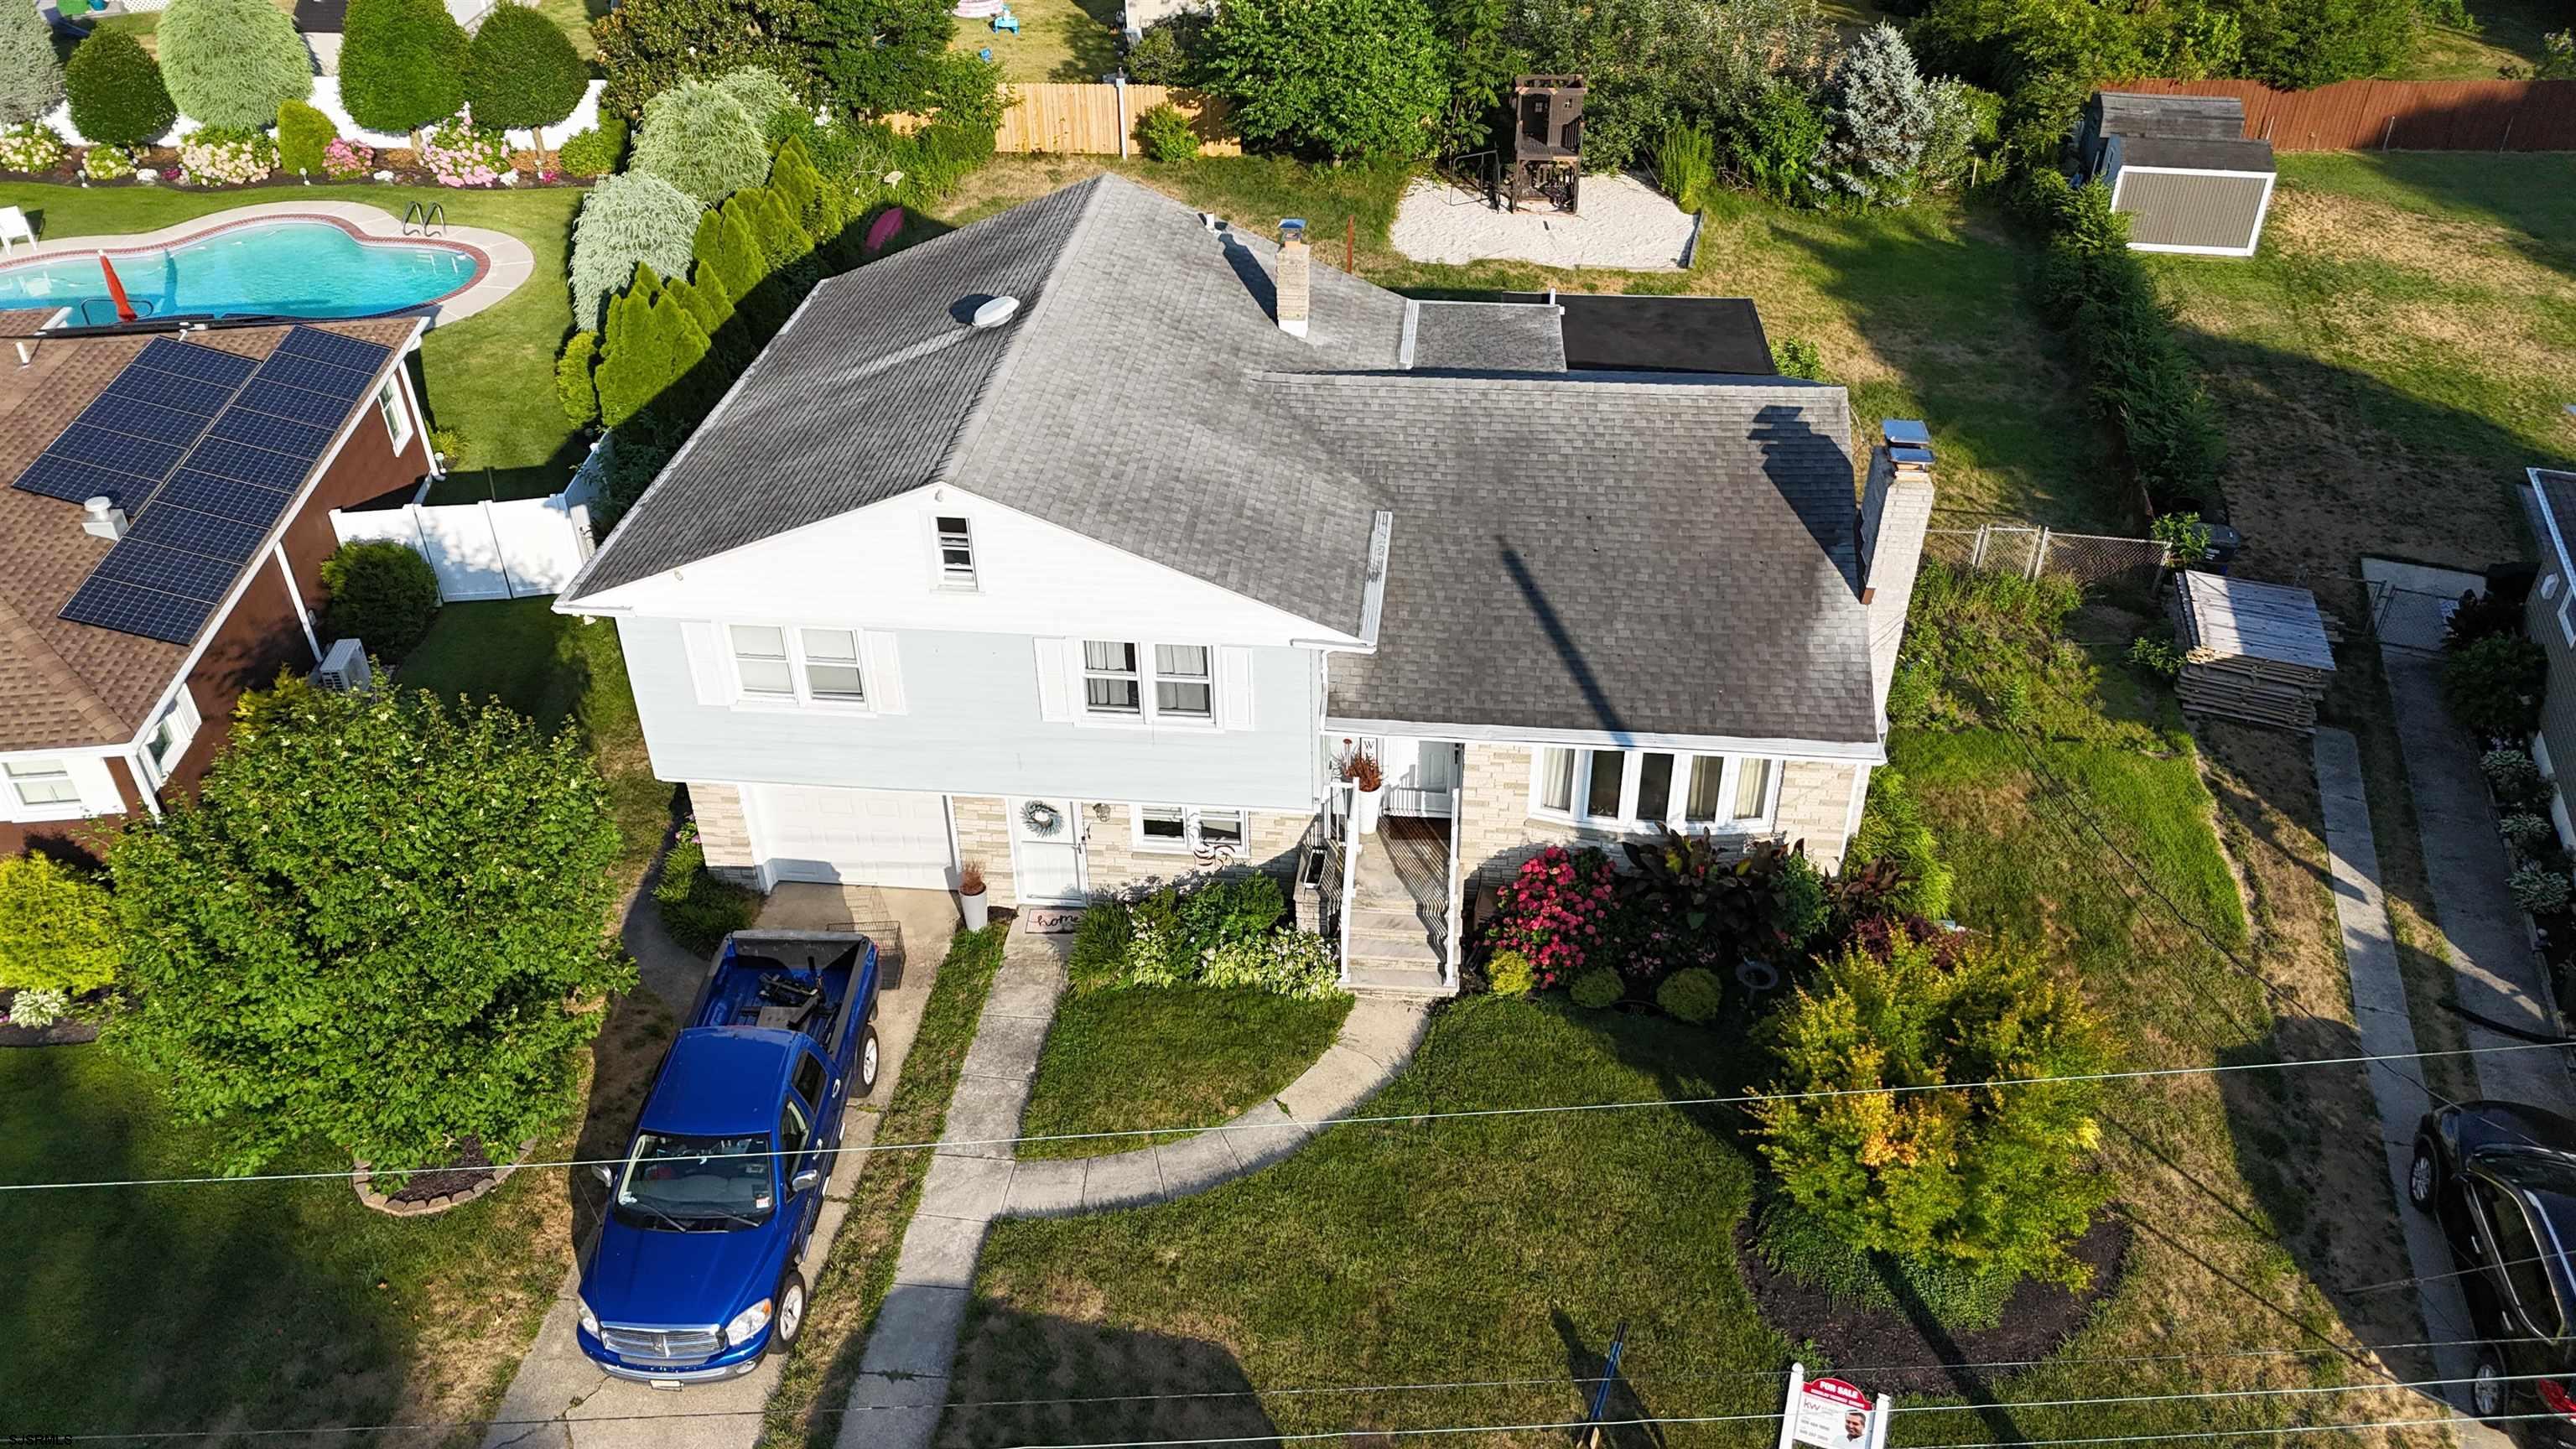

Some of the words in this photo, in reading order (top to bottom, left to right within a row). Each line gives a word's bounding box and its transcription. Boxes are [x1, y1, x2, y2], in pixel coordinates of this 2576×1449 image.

[1037, 915, 1079, 926] home
[1820, 1380, 1836, 1393] FOR
[1837, 1386, 1858, 1399] SALE
